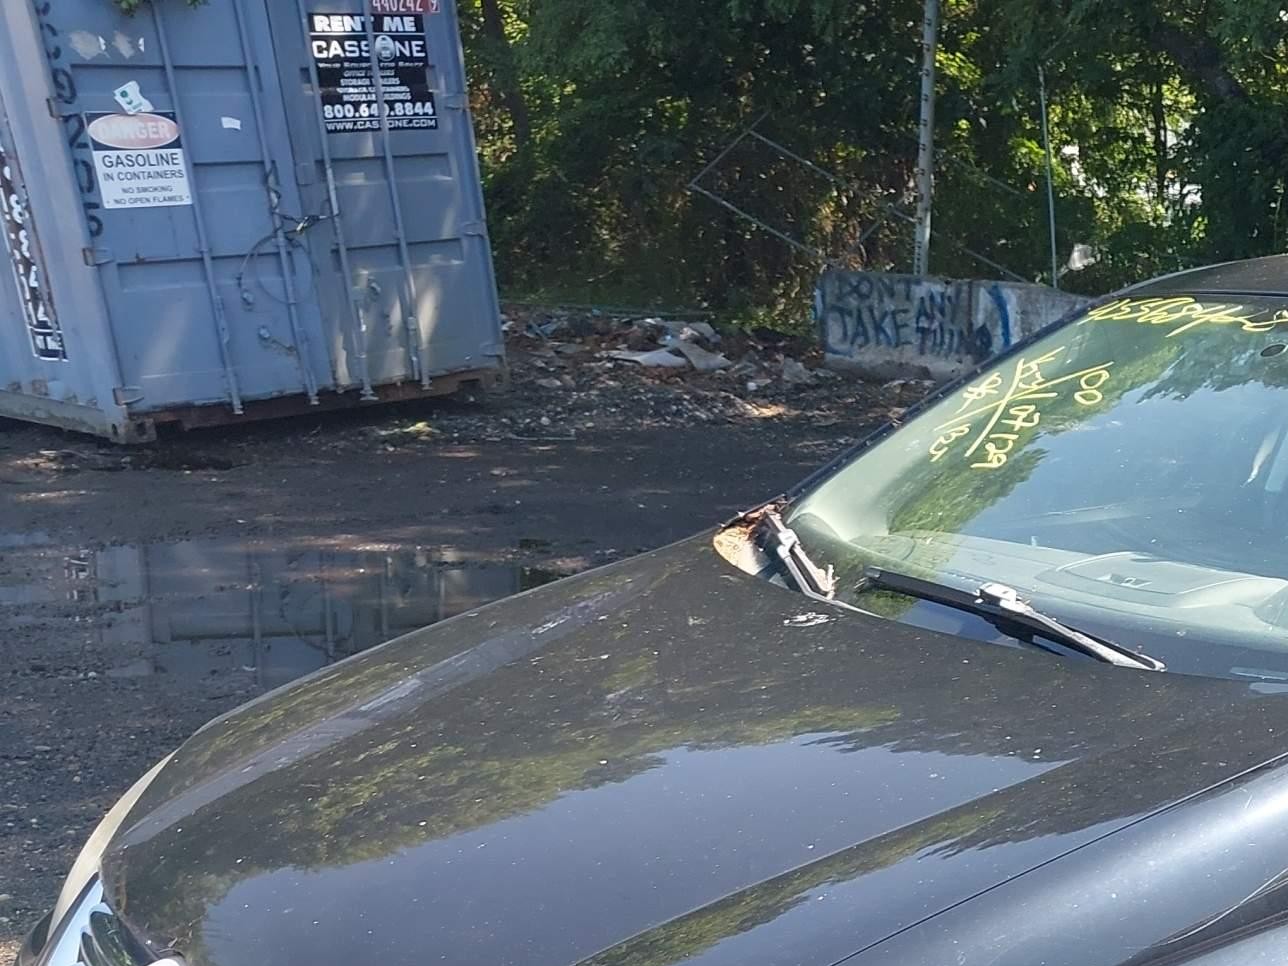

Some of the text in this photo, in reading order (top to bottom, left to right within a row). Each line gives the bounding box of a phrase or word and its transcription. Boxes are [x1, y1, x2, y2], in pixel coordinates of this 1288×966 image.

[383, 16, 416, 32] ME
[326, 119, 436, 130] WWW.CASONE.COM
[102, 152, 181, 169] GASOLINE
[103, 169, 185, 182] IN CONTAINERS
[121, 185, 173, 194] NO SMOKING
[113, 197, 127, 205] NO
[828, 303, 913, 349] TAKE
